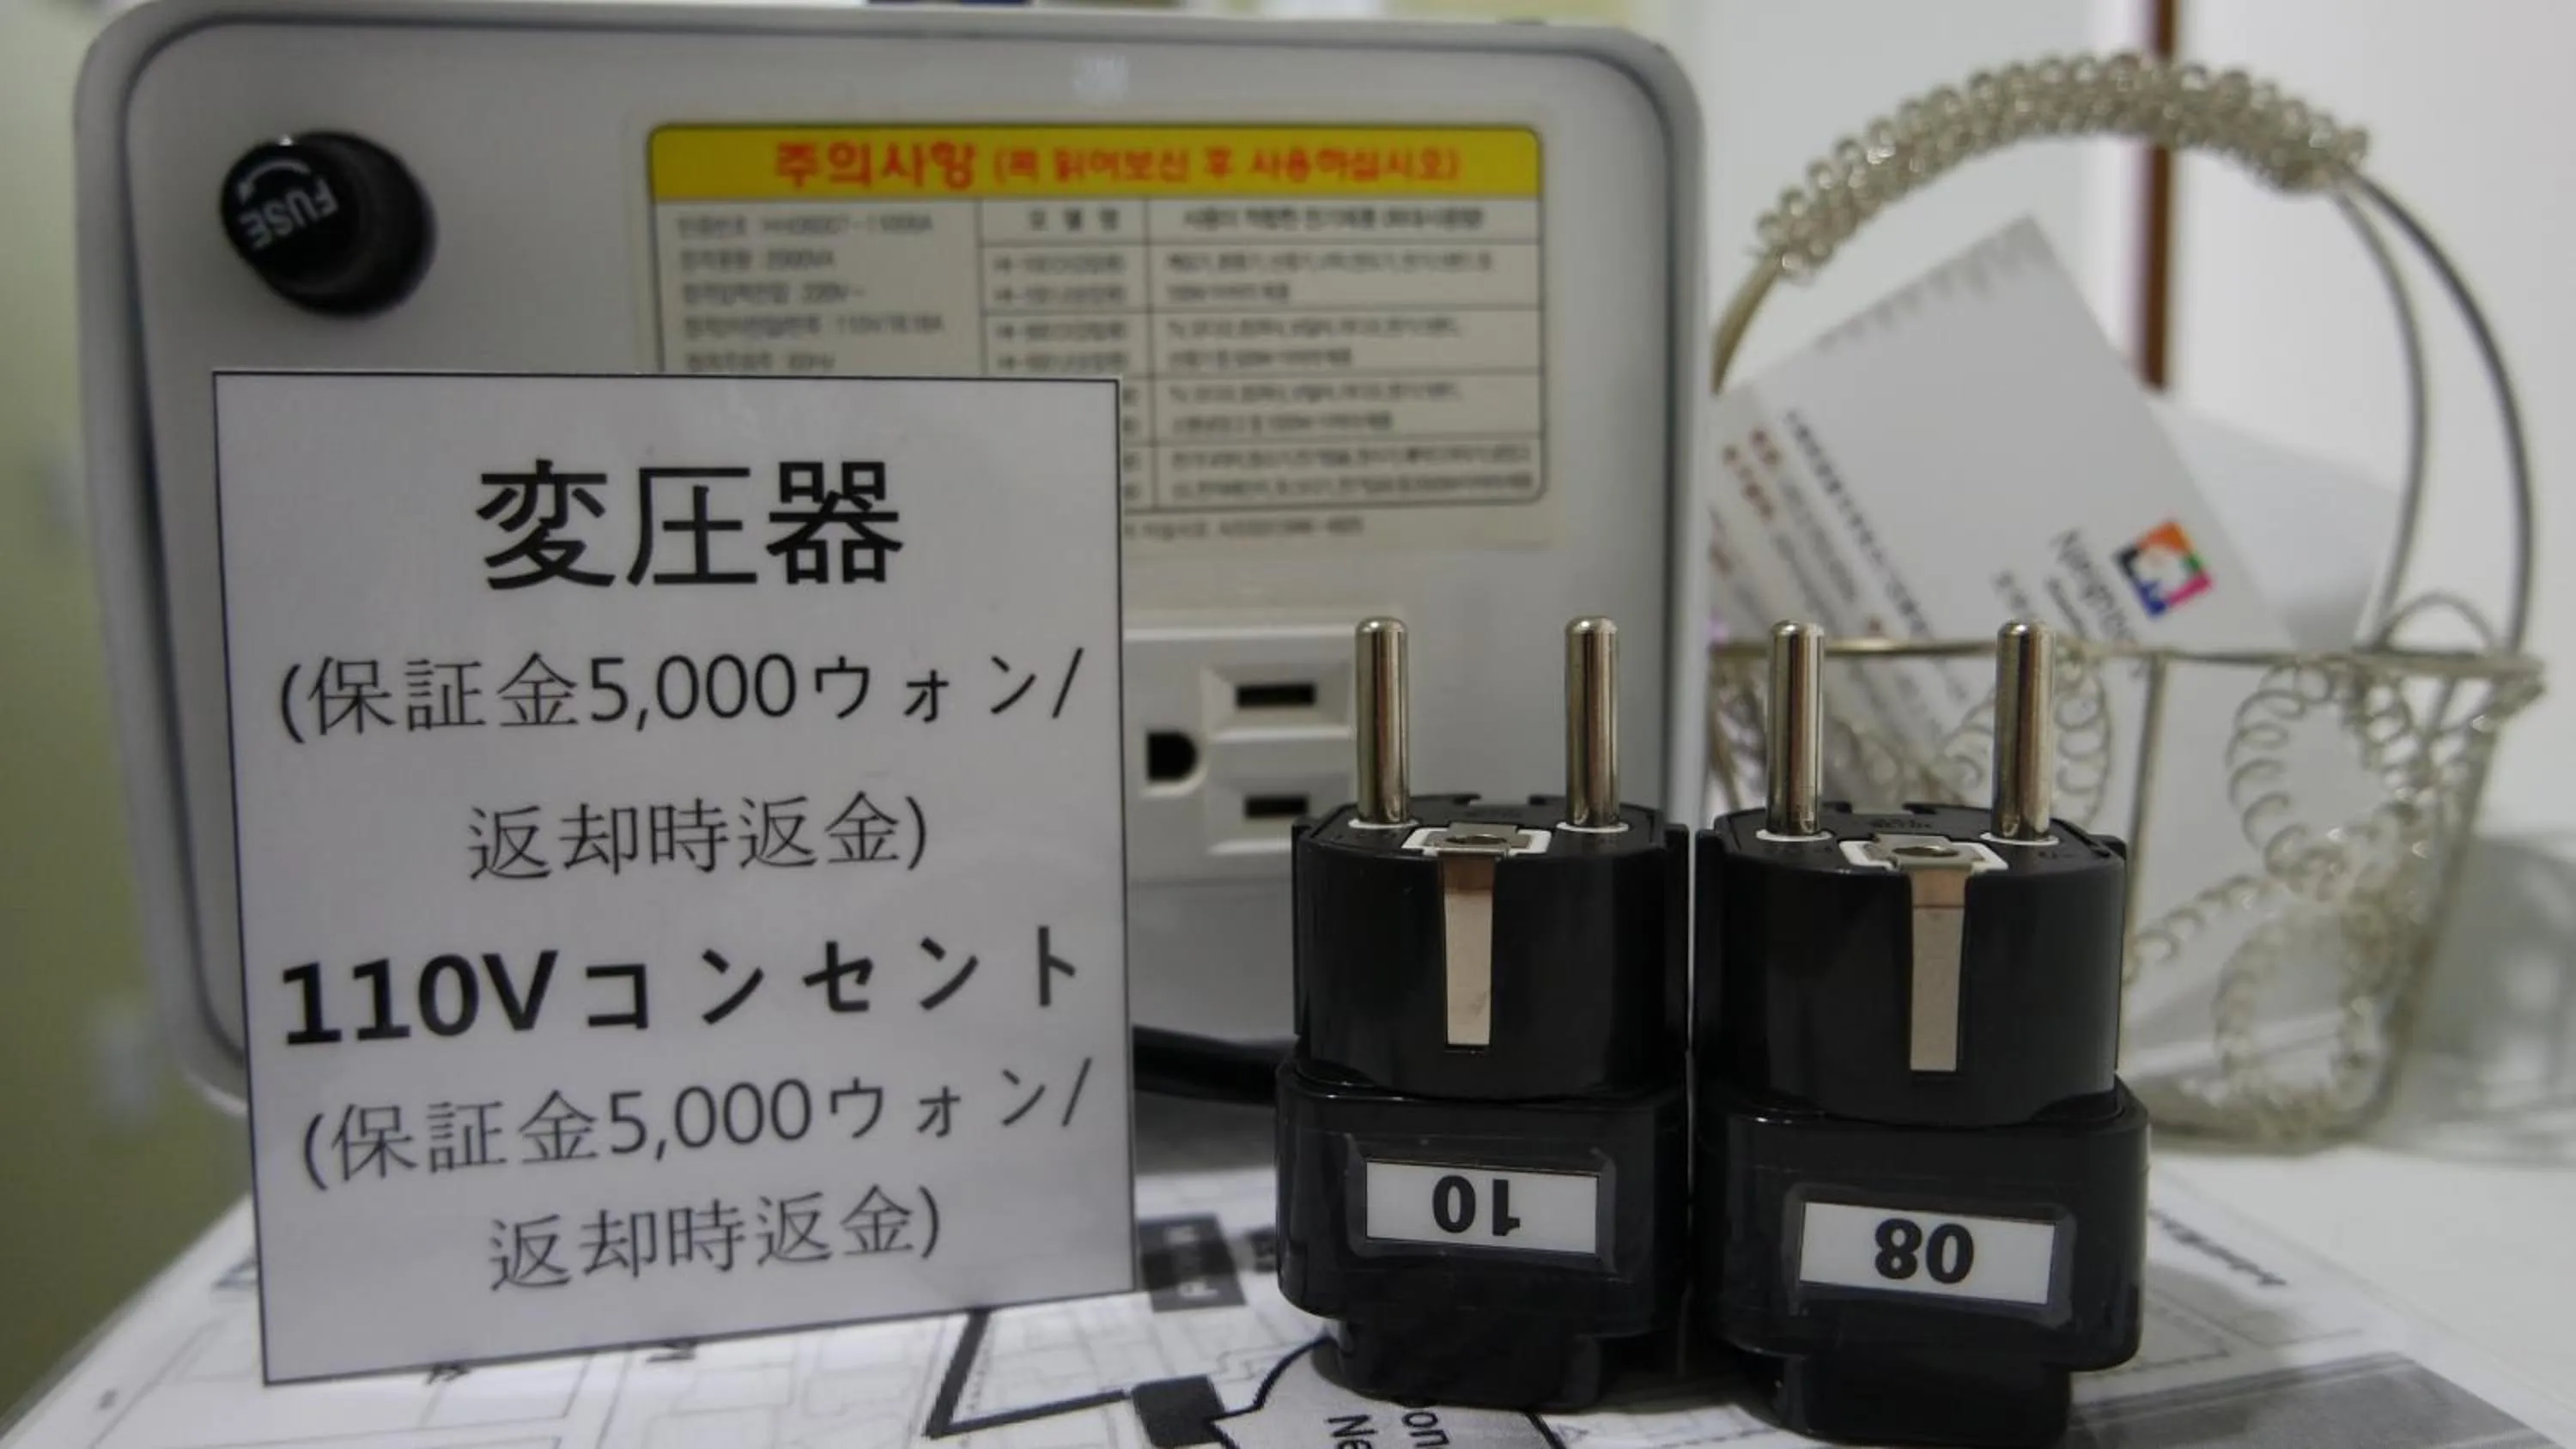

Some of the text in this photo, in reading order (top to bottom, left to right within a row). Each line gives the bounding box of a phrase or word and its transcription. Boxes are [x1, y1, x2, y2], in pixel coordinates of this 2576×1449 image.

[775, 140, 977, 191] 주의사항
[238, 175, 339, 252] FUSE
[475, 458, 904, 591] 変圧器
[468, 790, 927, 881] 返却時返金)
[282, 925, 1077, 1046] 110Vコンセント
[490, 1184, 941, 1291] 返却時返金)
[1431, 1174, 1522, 1237] 10
[1874, 1217, 1975, 1285] 08
